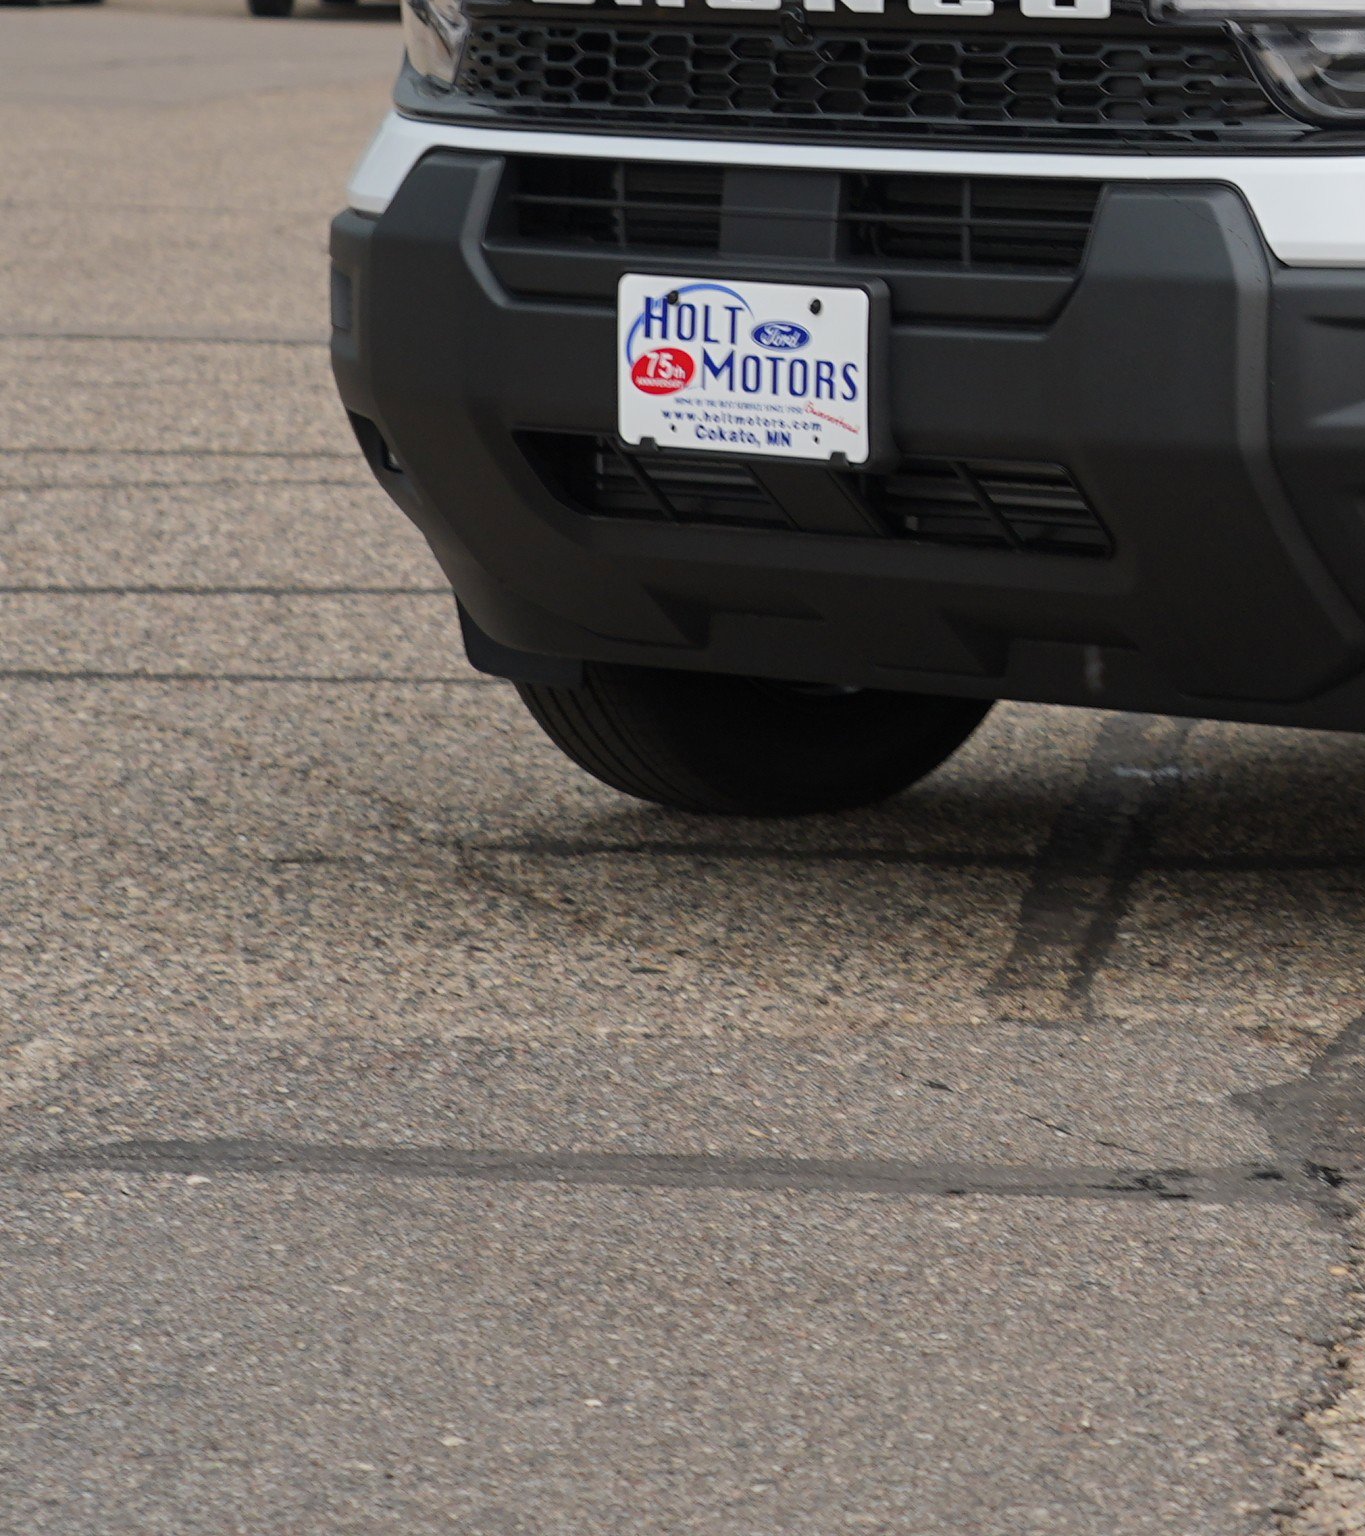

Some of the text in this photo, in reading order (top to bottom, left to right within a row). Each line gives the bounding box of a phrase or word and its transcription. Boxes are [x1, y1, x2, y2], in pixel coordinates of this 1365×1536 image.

[644, 296, 745, 346] HOLT
[643, 352, 686, 379] 75th
[702, 347, 858, 401] MOTORS
[662, 410, 821, 432] www.holtmotors.com
[766, 430, 792, 448] MN
